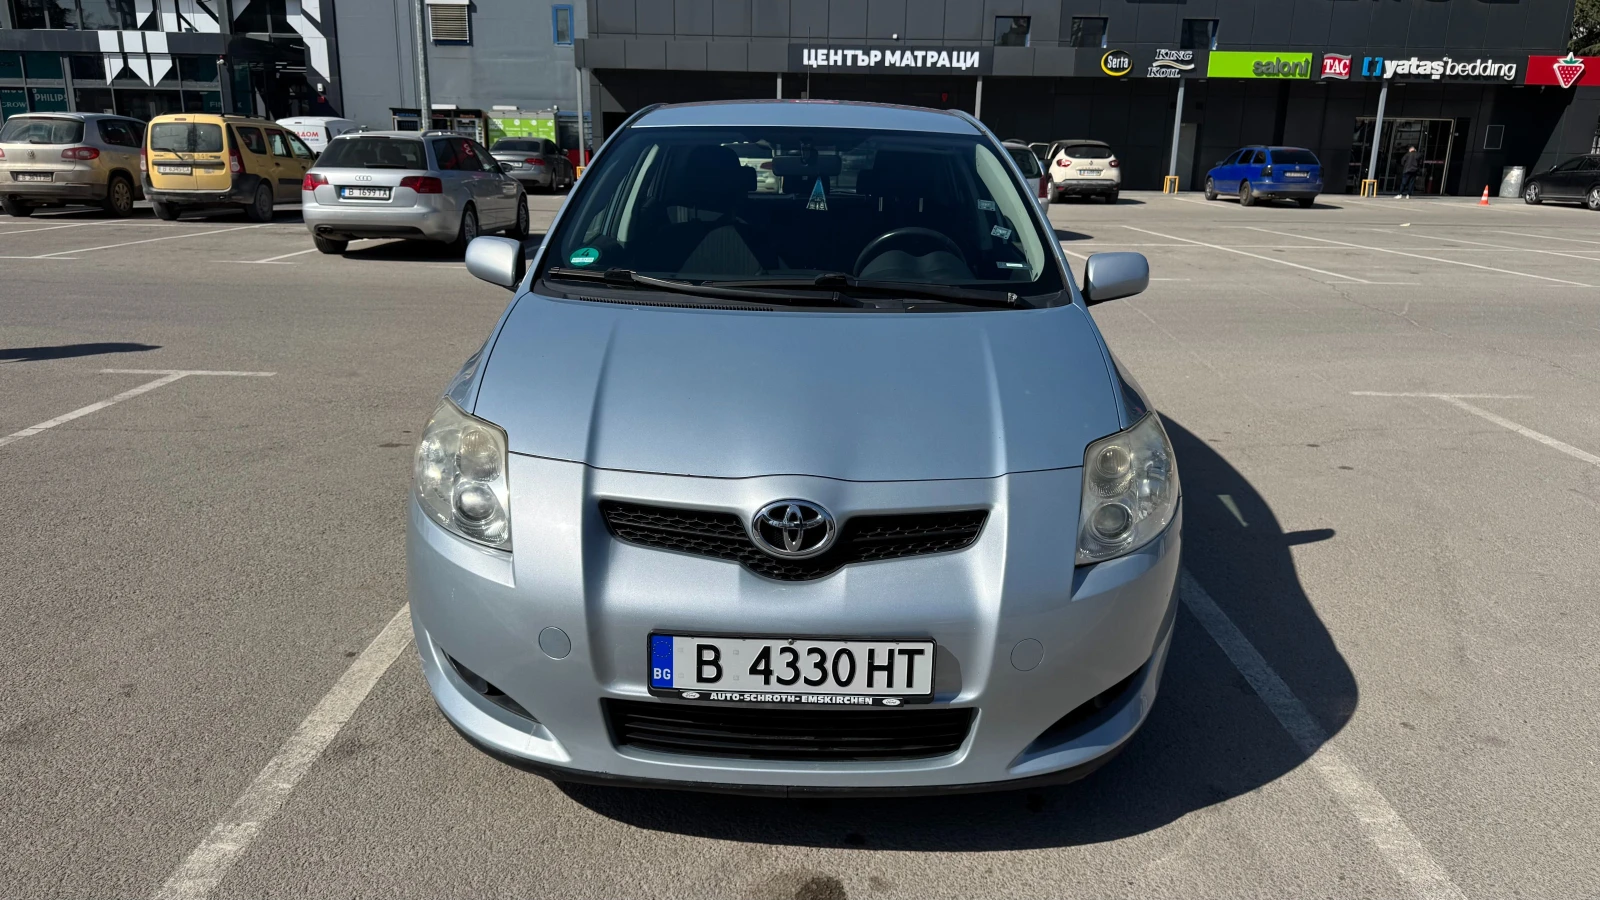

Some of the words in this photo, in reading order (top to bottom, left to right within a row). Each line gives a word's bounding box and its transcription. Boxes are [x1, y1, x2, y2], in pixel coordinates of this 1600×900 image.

[803, 49, 882, 68] ЦЕНТЪР
[885, 50, 980, 70] МАТРАЦИ
[1155, 49, 1193, 60] KING
[1107, 55, 1129, 68] Serta
[1384, 57, 1444, 79] yataş
[581, 249, 590, 257] 4
[696, 643, 723, 684] B
[749, 645, 856, 688] 4330
[866, 648, 925, 688] HT
[653, 668, 672, 681] BG
